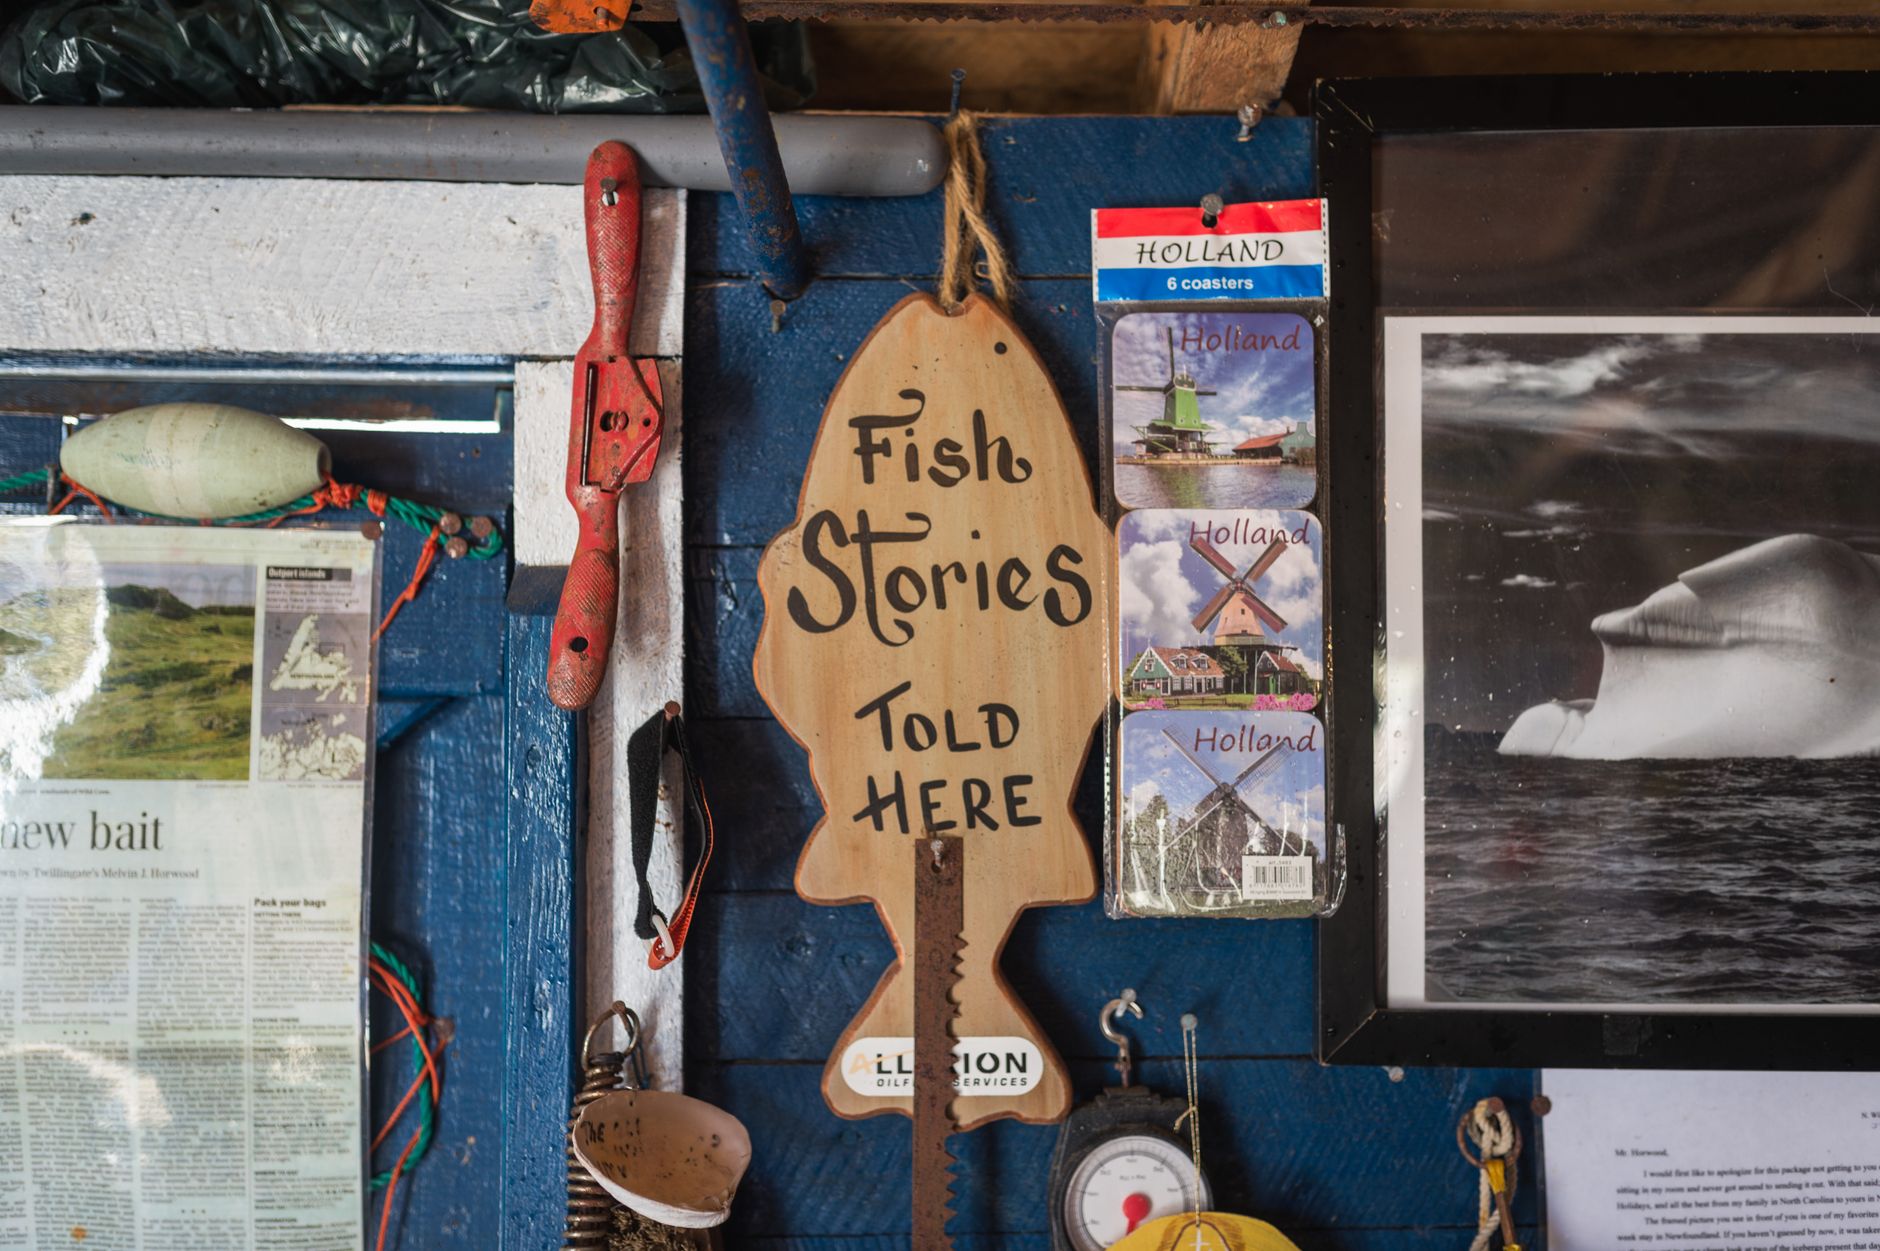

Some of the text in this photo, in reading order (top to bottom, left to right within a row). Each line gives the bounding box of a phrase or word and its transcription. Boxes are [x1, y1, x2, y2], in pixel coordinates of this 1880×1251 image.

[1136, 239, 1284, 264] HOLLAND
[1167, 277, 1254, 290] 6 coasters
[1181, 324, 1300, 352] Holland
[848, 388, 1033, 488] Fish
[1189, 518, 1310, 545] Holland
[787, 509, 1092, 647] Stories
[853, 681, 1020, 752] TOLD
[1194, 724, 1316, 752] Holland
[853, 770, 1043, 834] HERE
[1, 809, 164, 850] new bait
[33, 867, 99, 880] Twillingate's
[102, 868, 138, 878] Melvin
[150, 868, 199, 879] Horwood
[254, 899, 327, 908] Pack your bags
[848, 1052, 1027, 1074] ALLION
[952, 1077, 1028, 1087] SERVICES
[1674, 1169, 1689, 1177] first
[1691, 1168, 1705, 1177] like
[1717, 1168, 1752, 1178] apologize
[1754, 1166, 1764, 1175] for
[1766, 1165, 1780, 1174] this
[1781, 1164, 1812, 1175] package
[1813, 1165, 1825, 1173] not
[1827, 1164, 1852, 1173] getting
[1863, 1165, 1877, 1173] you
[1616, 1185, 1639, 1195] sitting
[1651, 1187, 1662, 1195] my
[1687, 1184, 1700, 1193] and
[1724, 1184, 1736, 1193] got
[1738, 1183, 1763, 1191] around
[1765, 1182, 1774, 1190] to
[1775, 1181, 1802, 1190] sending
[1828, 1179, 1846, 1187] With
[1847, 1179, 1862, 1187] that
[1670, 1200, 1679, 1209] all
[1681, 1200, 1692, 1209] the
[1694, 1200, 1709, 1208] best
[1711, 1199, 1729, 1207] from
[1745, 1198, 1768, 1208] family
[1780, 1197, 1801, 1205] North
[1803, 1196, 1834, 1204] Carolina
[1845, 1196, 1866, 1205] yours
[1868, 1194, 1875, 1202] in
[1645, 1217, 1658, 1225] The
[1661, 1216, 1687, 1225] framed
[1689, 1216, 1714, 1225] picture
[1716, 1216, 1730, 1225] you
[1746, 1214, 1753, 1222] in
[1755, 1213, 1773, 1222] front
[1774, 1213, 1783, 1221] of
[1784, 1214, 1798, 1222] you
[1823, 1211, 1832, 1219] of
[1833, 1212, 1845, 1220] my
[1847, 1210, 1879, 1219] favorites
[1639, 1233, 1653, 1243] stay
[1656, 1233, 1663, 1241] in
[1665, 1230, 1720, 1241] Newfoundland.
[1723, 1230, 1731, 1239] If
[1731, 1231, 1746, 1240] you
[1747, 1229, 1775, 1239] haven't
[1777, 1228, 1806, 1238] guessed
[1807, 1227, 1816, 1237] by
[1818, 1228, 1837, 1236] now,
[1839, 1227, 1844, 1235] it
[1792, 1242, 1823, 1251] icebergs
[1825, 1241, 1851, 1251] present
[1853, 1240, 1867, 1250] that
